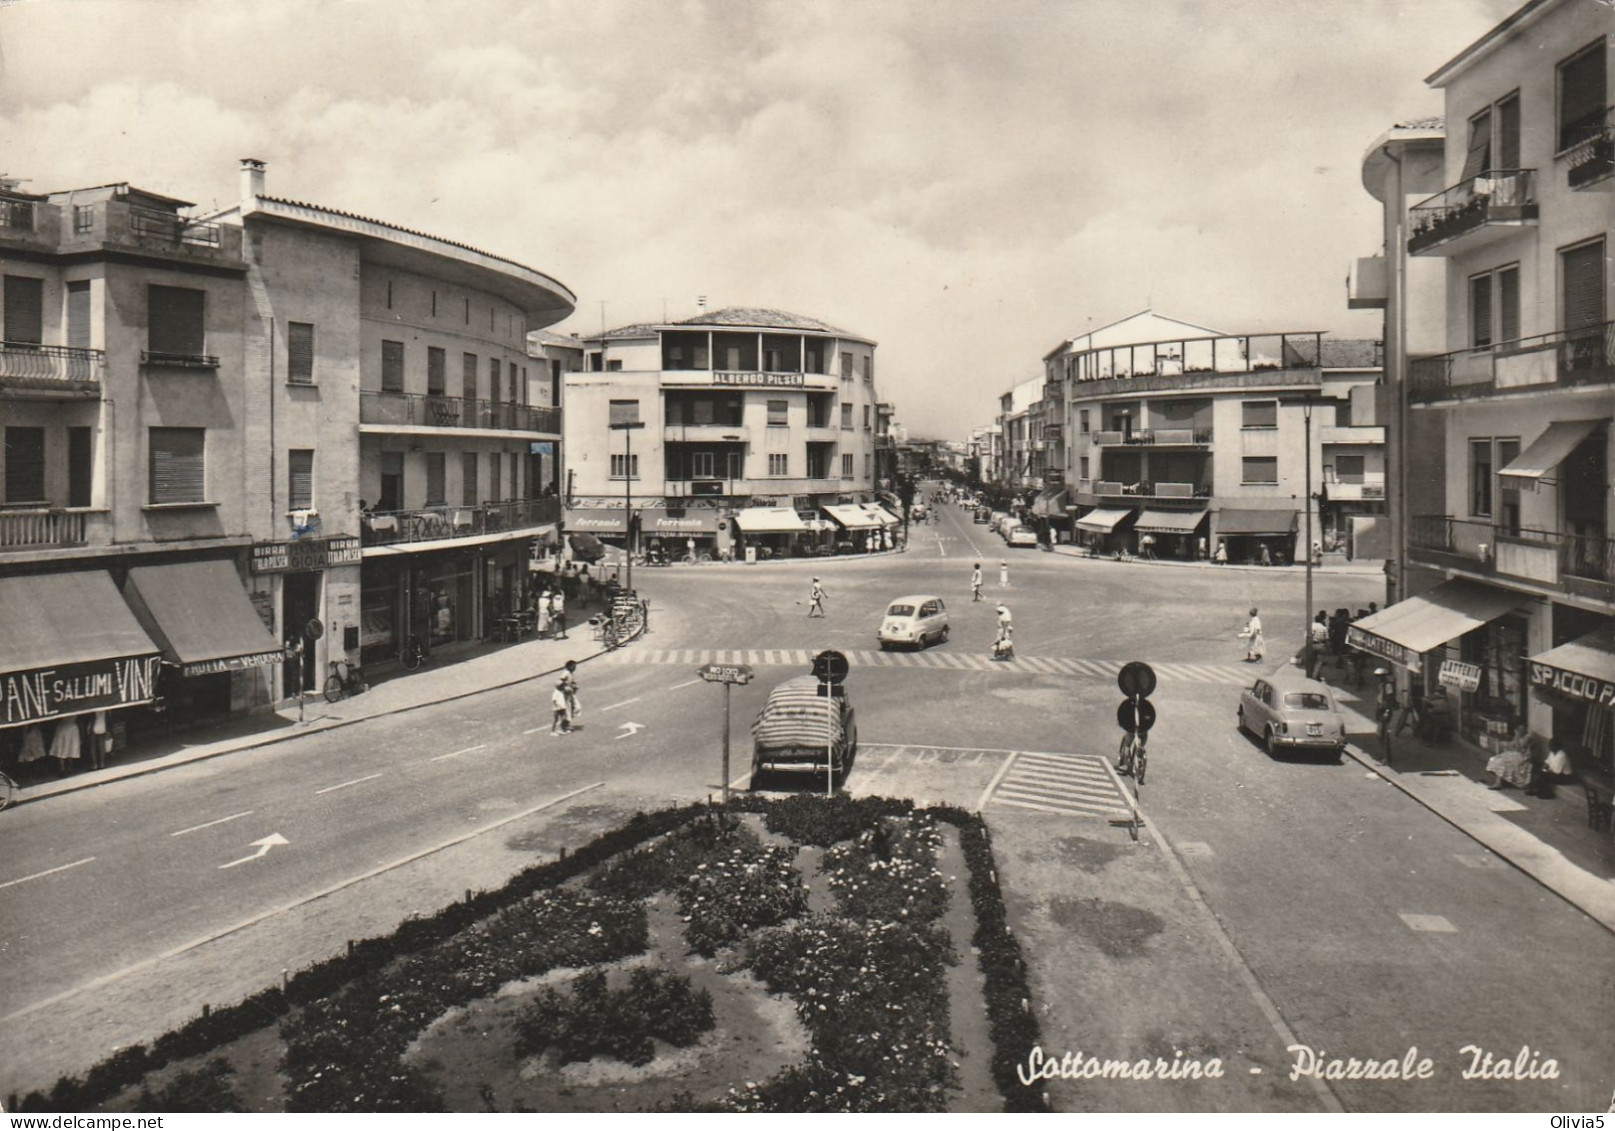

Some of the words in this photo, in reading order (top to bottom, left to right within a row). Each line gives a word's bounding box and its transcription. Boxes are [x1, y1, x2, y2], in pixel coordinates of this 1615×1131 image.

[714, 373, 763, 384] ALBERGO
[767, 374, 803, 385] PILSEN
[253, 545, 286, 557] BIRRA
[330, 539, 359, 550] BIRRA
[1442, 661, 1480, 679] LATTERIA
[1532, 664, 1597, 700] SPACCIO
[0, 671, 58, 722] ANE
[53, 673, 112, 702] SALUMI
